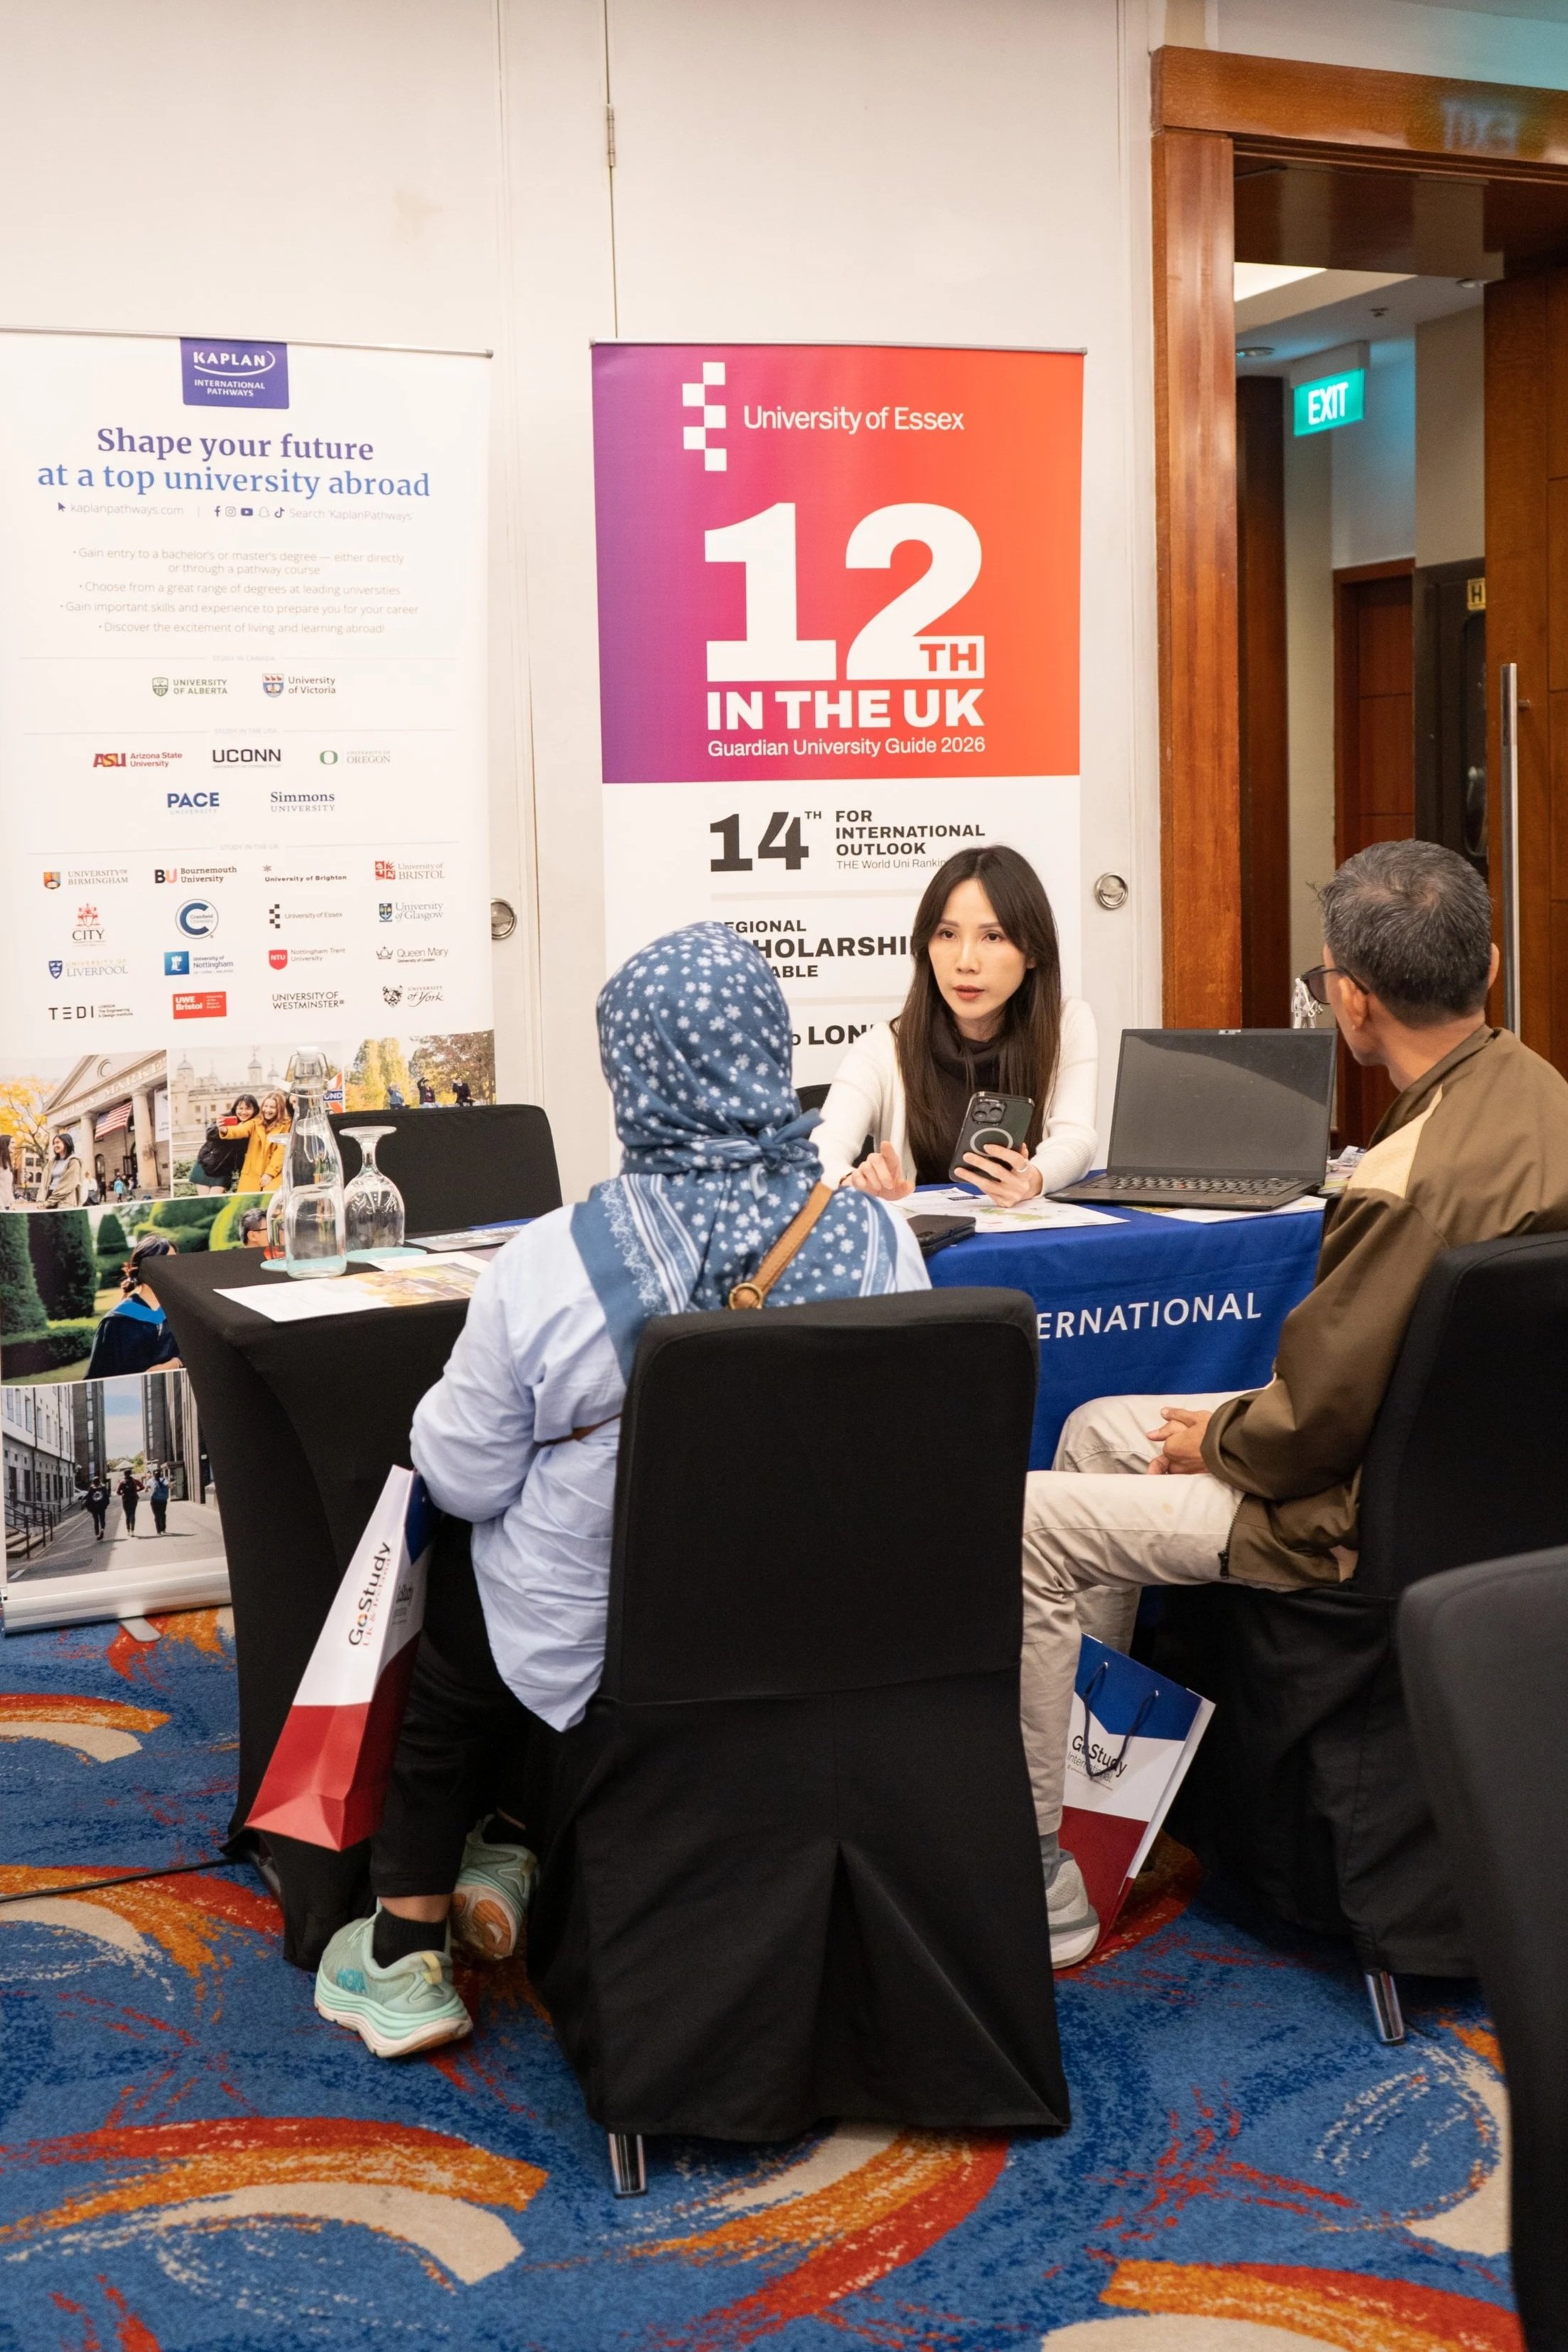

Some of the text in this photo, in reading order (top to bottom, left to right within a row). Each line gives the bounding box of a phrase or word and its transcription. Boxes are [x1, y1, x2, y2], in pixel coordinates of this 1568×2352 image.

[193, 351, 265, 367] KAPLAN
[194, 380, 265, 389] INTERNATIONAL
[207, 387, 254, 396] PATHWAYS
[1308, 382, 1349, 425] EXIT
[744, 405, 965, 435] University of Essex
[97, 427, 373, 462] Shape your future
[38, 464, 430, 499] at a top university abroad
[70, 503, 184, 517] kaplanpathways.com
[289, 508, 325, 519] Search
[79, 548, 104, 558] Gain
[107, 550, 136, 561] entry
[138, 550, 149, 558] to
[162, 549, 214, 559] bachelor's
[232, 551, 277, 561] master's
[280, 551, 317, 563] degree
[333, 553, 363, 563] either
[367, 553, 404, 565] directly
[182, 564, 224, 575] through
[237, 565, 282, 577] pathway
[84, 582, 126, 592] Choose
[129, 582, 155, 592] from
[167, 584, 194, 595] great
[197, 585, 227, 596] range
[230, 584, 241, 592] of
[243, 584, 287, 596] degrees
[289, 585, 300, 594] at
[303, 585, 341, 596] leading
[343, 585, 401, 595] universities
[705, 502, 984, 682] 12
[65, 601, 91, 612] Gain
[94, 602, 148, 614] important
[151, 602, 175, 612] skills
[178, 603, 198, 612] and
[201, 604, 259, 614] experience
[263, 604, 274, 613] to
[277, 605, 319, 616] prepare
[321, 606, 341, 616] you
[343, 604, 358, 614] for
[360, 606, 384, 616] your
[104, 622, 385, 636] Discover the excitement of living and learning abroad!
[920, 643, 977, 672] TH
[288, 676, 336, 685] University
[707, 689, 985, 730] IN THE UK
[708, 736, 985, 758] Guardian University Guide 2026
[93, 753, 127, 768] ASU
[212, 749, 282, 763] UCONN
[346, 756, 391, 764] OREGON
[167, 792, 220, 807] PACE
[270, 791, 335, 802] Simmons
[805, 811, 822, 819] TH
[836, 810, 872, 822] FOR
[836, 824, 985, 839] INTERNATIONAL
[710, 811, 810, 873] 14
[837, 843, 927, 856] OUTLOOK
[837, 858, 946, 869] THE World Uni Rankin
[67, 869, 119, 878] UNIVERSITY
[154, 868, 177, 883] BU
[180, 875, 224, 883] University
[398, 870, 445, 880] BRISTOL
[68, 877, 128, 885] BIRMINGHAM
[395, 902, 443, 912] University
[395, 910, 443, 920] of Glasgow
[724, 920, 806, 933] GIONAL
[72, 929, 104, 941] CITY
[397, 947, 448, 957] Queen Mary
[753, 937, 910, 958] HOLARSHI
[67, 966, 128, 977] LIVERPOOL
[272, 992, 324, 1001] UNIVERSITY
[407, 990, 443, 1007] of York
[272, 1000, 338, 1010] WESTMINSTER
[48, 1005, 94, 1020] TEDI
[808, 1025, 874, 1045] LON
[1037, 1291, 1261, 1340] ERNATIONAL
[348, 1542, 390, 1645] GoStudy
